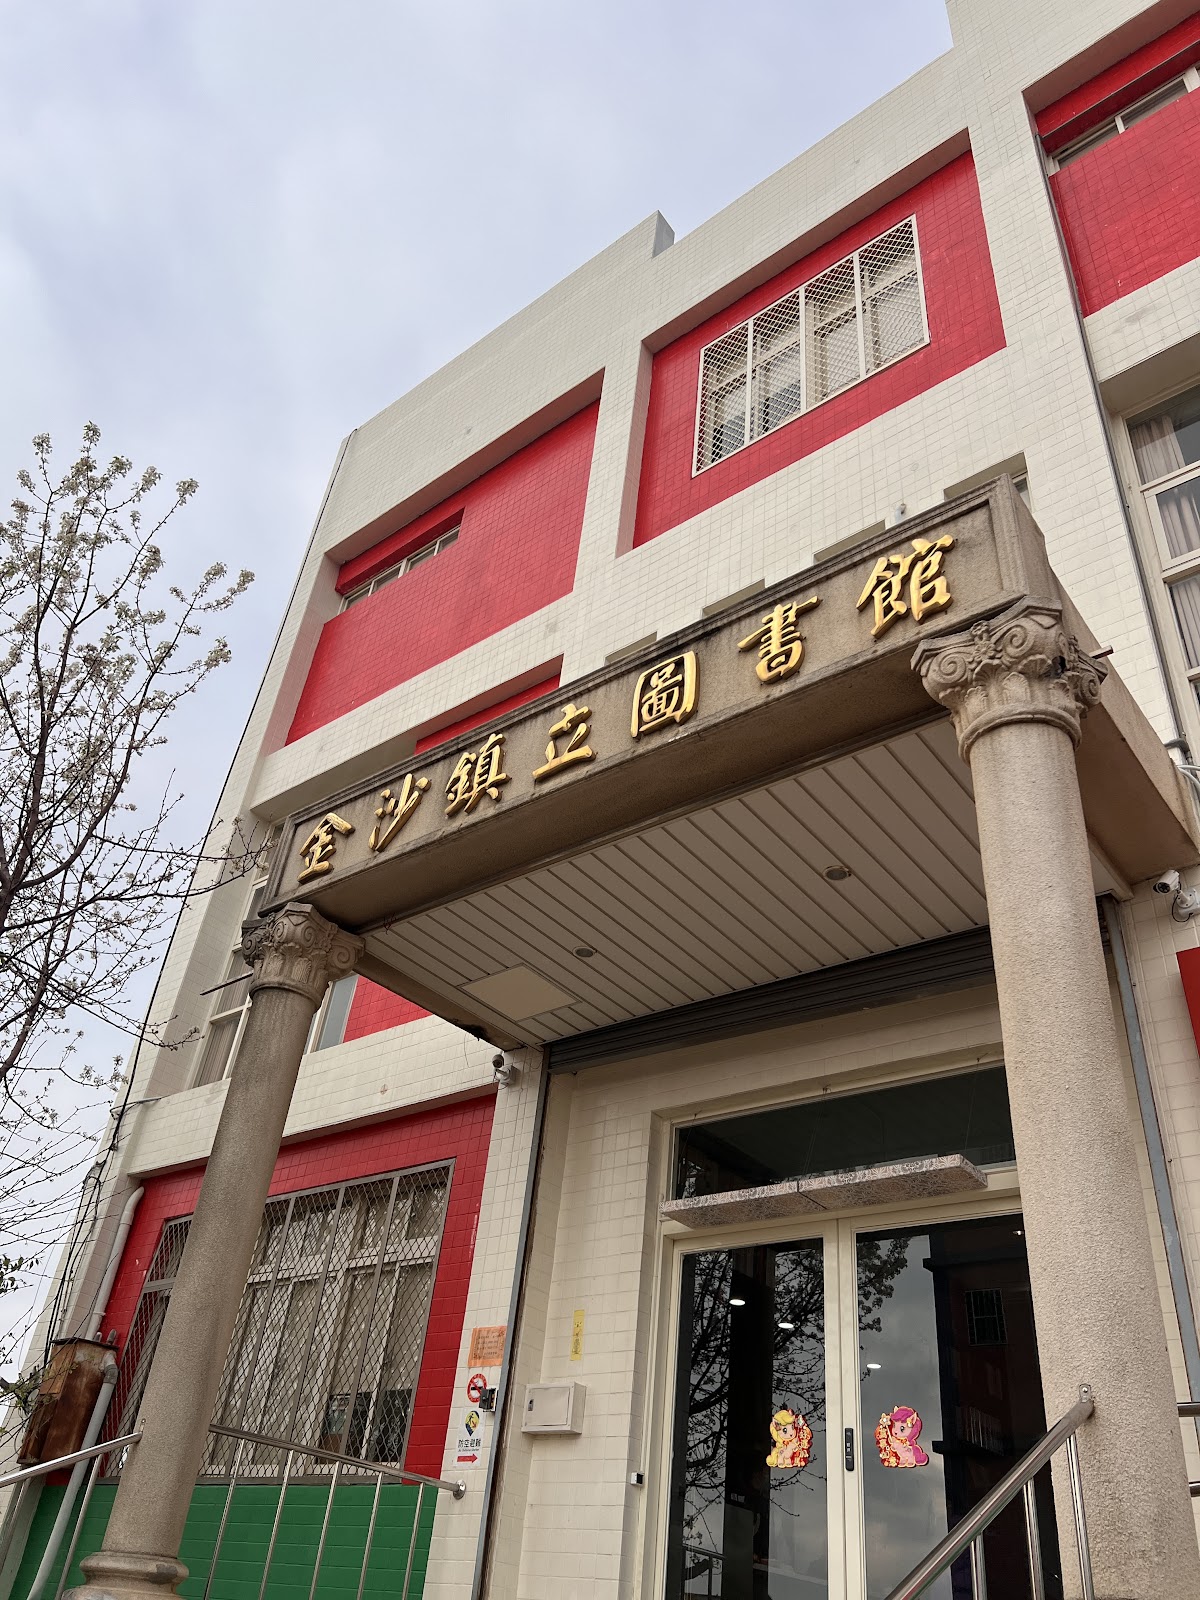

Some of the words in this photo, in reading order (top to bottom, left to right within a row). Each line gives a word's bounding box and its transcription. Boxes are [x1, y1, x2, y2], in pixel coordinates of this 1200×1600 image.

[298, 533, 955, 882] 金沙鎮立圖書館
